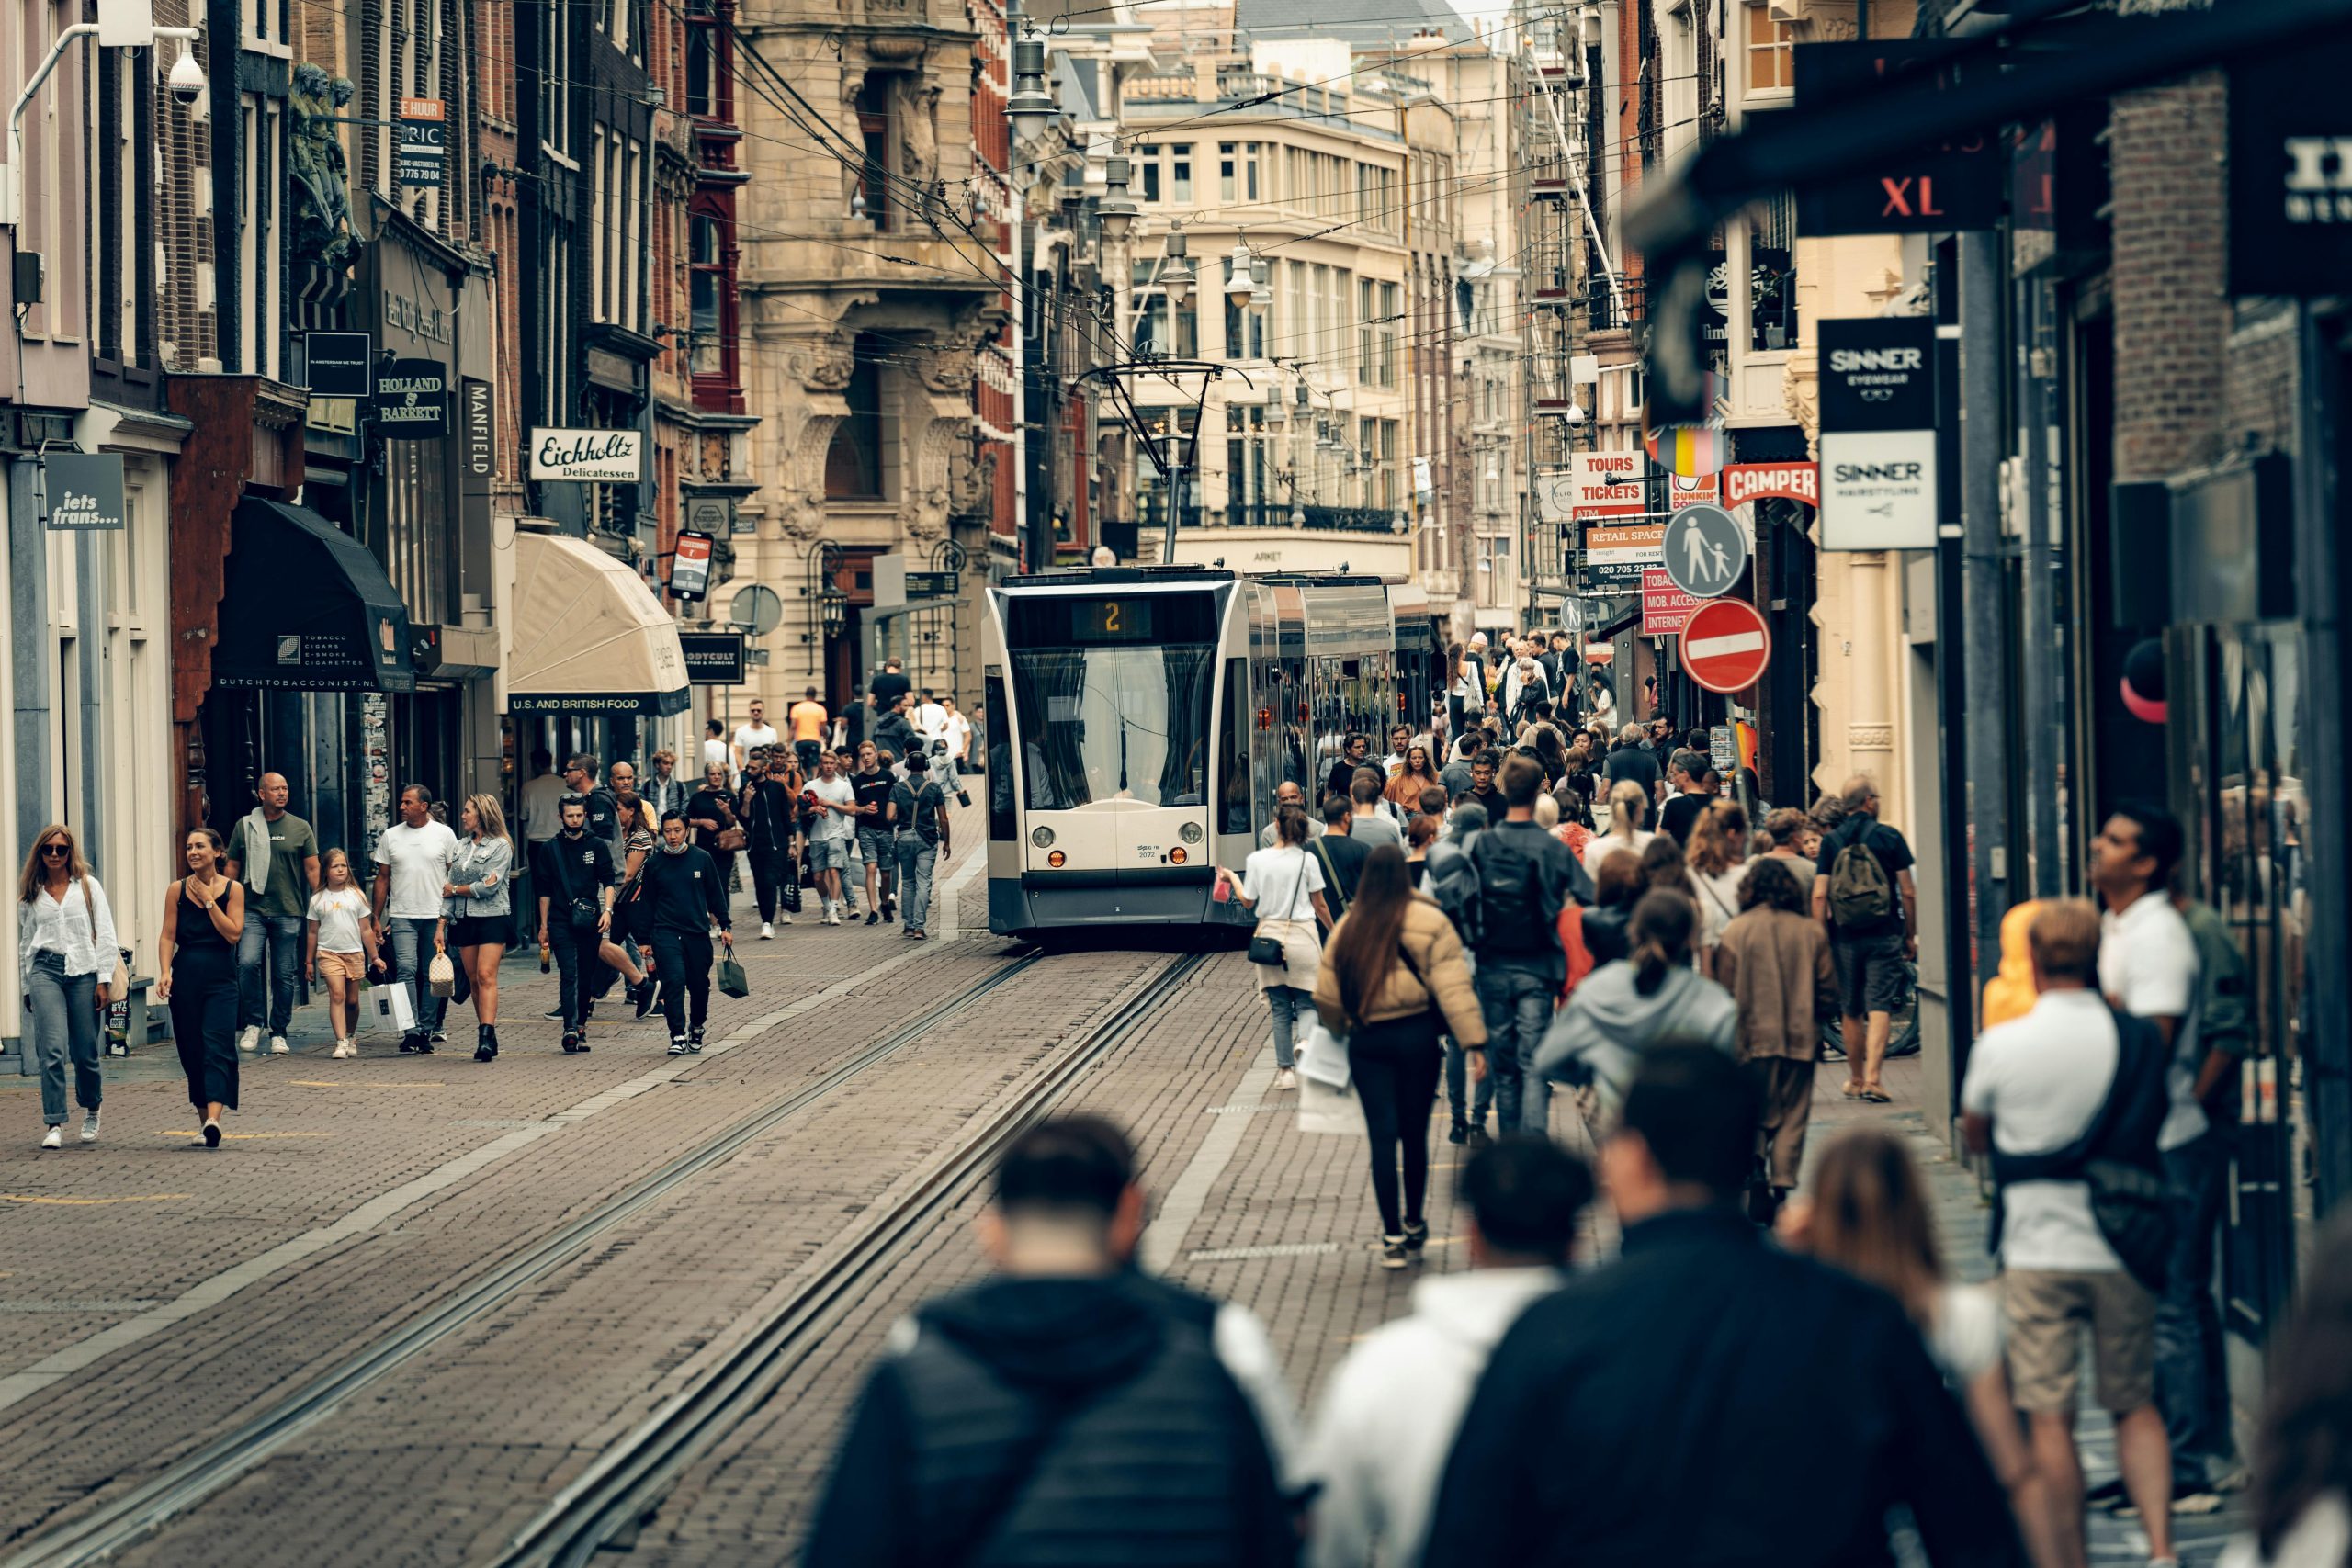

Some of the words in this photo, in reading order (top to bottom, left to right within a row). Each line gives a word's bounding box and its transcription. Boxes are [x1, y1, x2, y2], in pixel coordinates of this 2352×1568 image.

[410, 102, 438, 117] HUUR
[409, 127, 439, 144] BIC
[406, 169, 419, 179] 775
[421, 170, 429, 180] 79
[430, 172, 439, 181] 04
[1882, 176, 1943, 217] XL
[1830, 348, 1922, 372] SINNER
[379, 378, 442, 393] HOLLAND
[1847, 374, 1908, 386] EYEWEAR
[405, 393, 418, 407] &
[381, 406, 442, 422] BARRETT
[471, 387, 489, 473] MANFIELD
[539, 434, 633, 467] Eichholtz
[1587, 457, 1634, 472] TOURS
[563, 468, 634, 478] Delicatessen
[1834, 462, 1922, 483] SINNER
[1729, 469, 1816, 501] CAMPER
[1837, 486, 1920, 497] HAIRSTYLING
[1581, 485, 1640, 500] TICKETS
[1673, 492, 1716, 501] DUNKIN'
[63, 491, 97, 510] iets
[52, 506, 119, 525] frans...
[1576, 509, 1600, 518] ATM
[1592, 532, 1628, 542] RETAIL
[1631, 530, 1664, 540] SPACE
[1254, 551, 1282, 561] ARKET
[1599, 566, 1614, 574] 020
[1616, 565, 1632, 573] 705
[1647, 596, 1669, 608] MOB.
[1105, 602, 1119, 631] 2
[1648, 615, 1687, 628] INTERNET
[685, 652, 735, 660] ODYCULT
[220, 678, 376, 687] DUTCHTOBACCONIST.NL
[514, 700, 534, 709] U.S.
[536, 700, 560, 709] AND
[562, 699, 605, 709] BRITISH
[607, 699, 639, 709] FOOD
